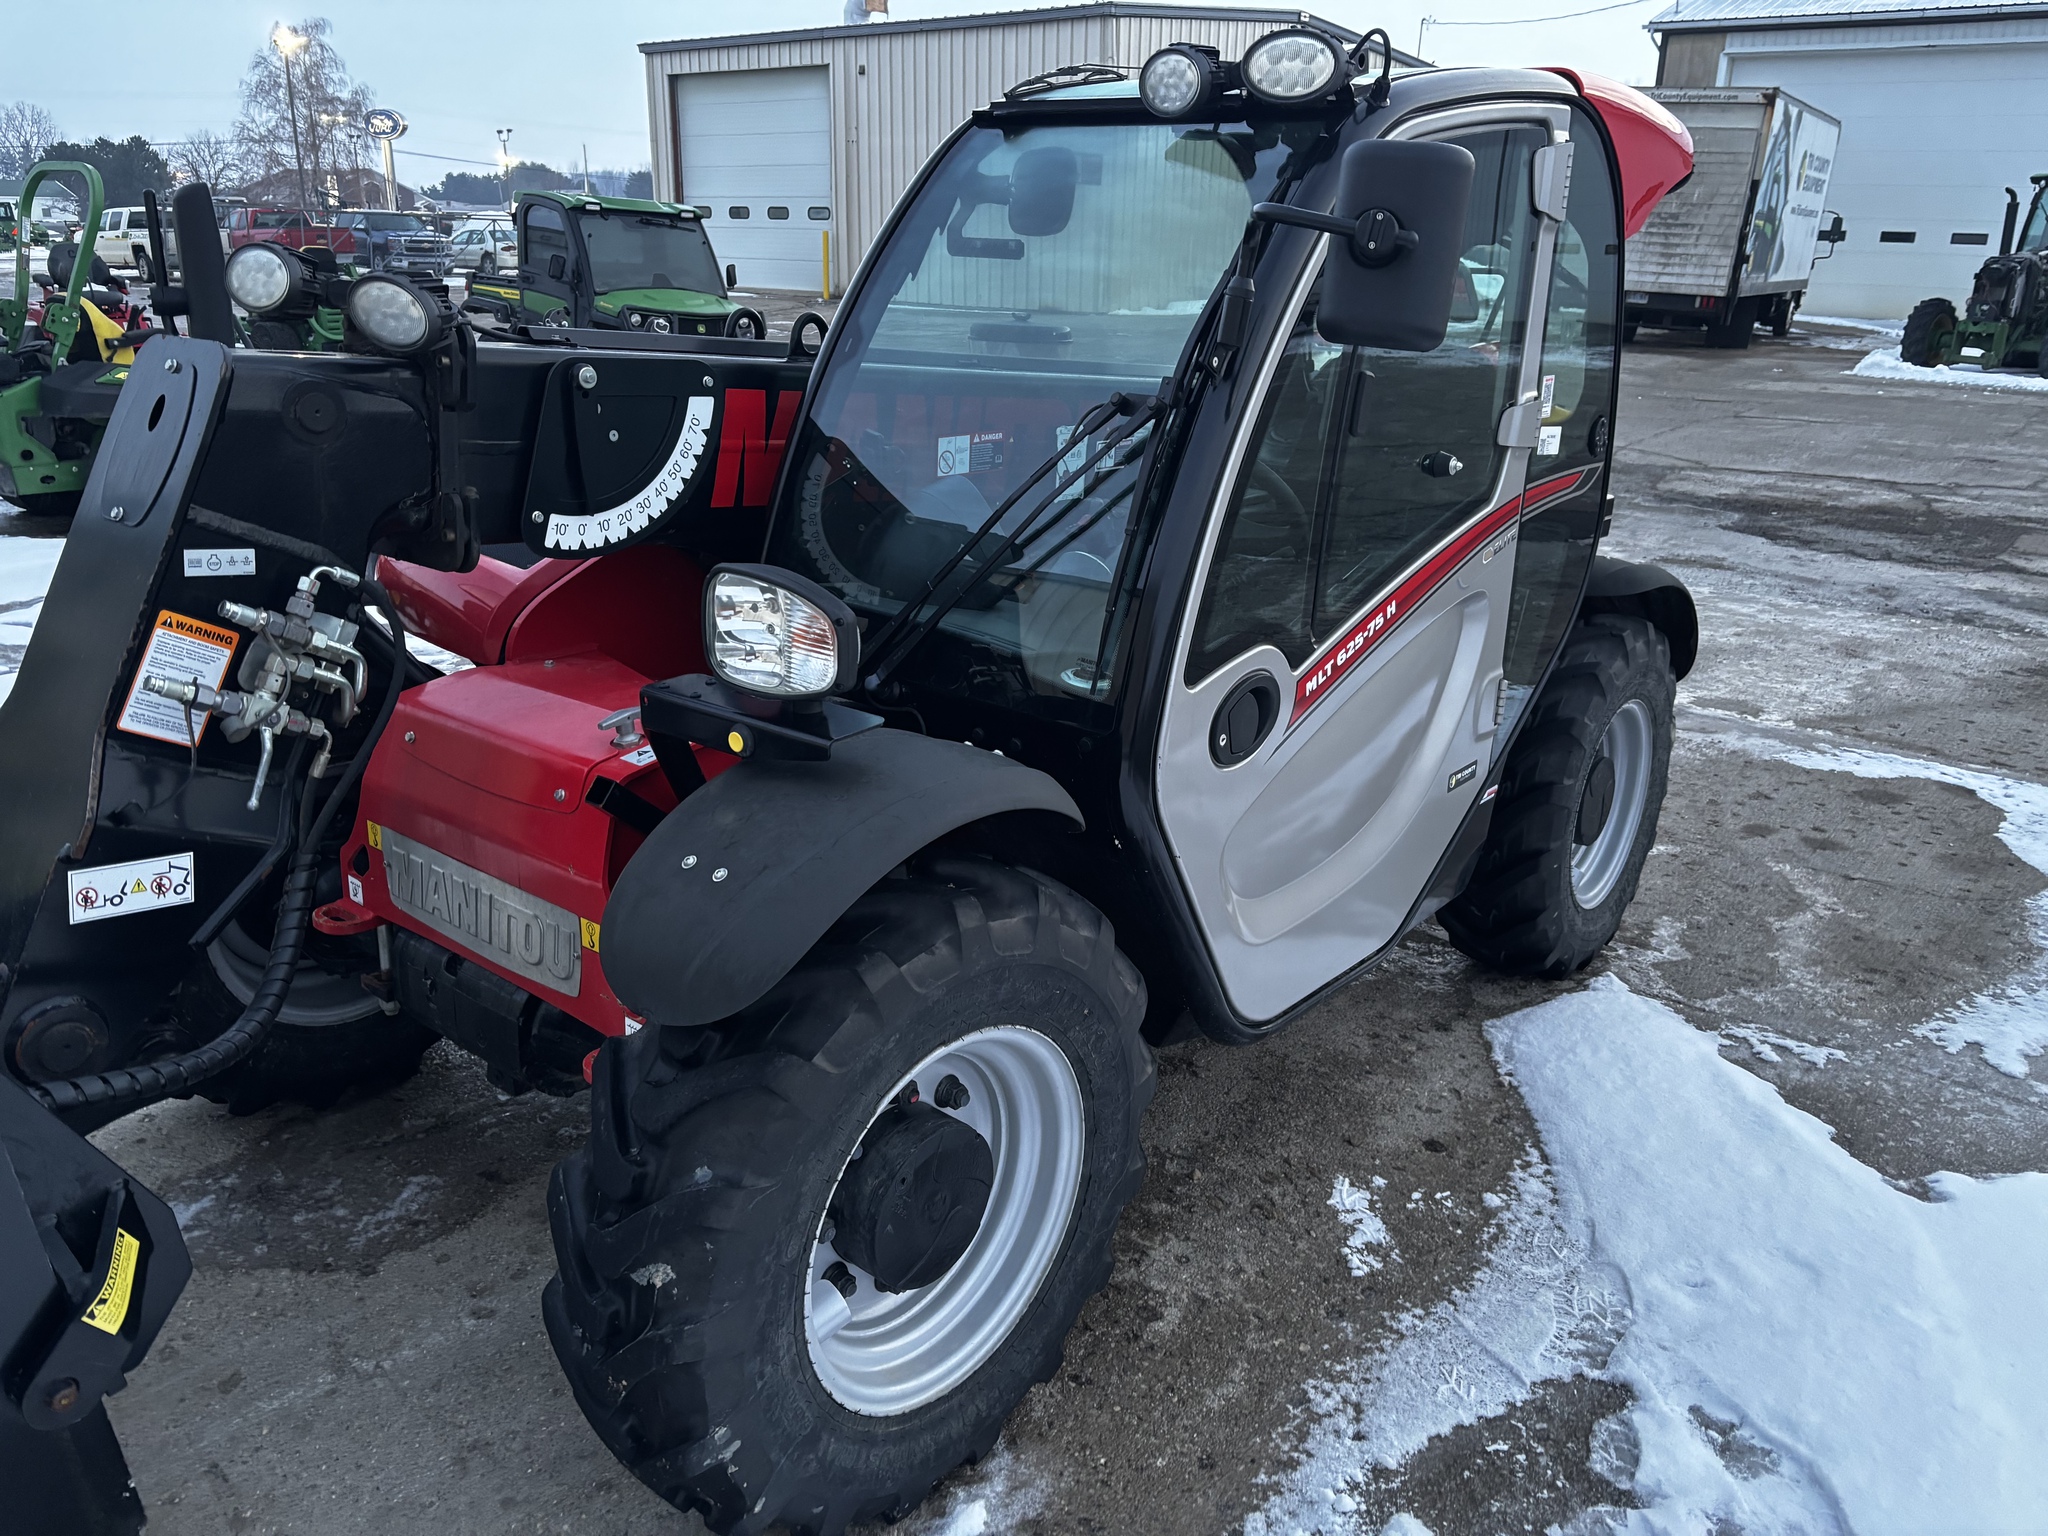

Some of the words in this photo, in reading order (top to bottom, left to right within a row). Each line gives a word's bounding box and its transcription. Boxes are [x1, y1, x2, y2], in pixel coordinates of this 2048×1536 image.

[981, 433, 1003, 441] DANGER
[176, 620, 234, 646] WARNING
[1306, 659, 1335, 697] MLT
[1336, 612, 1384, 666] 625-75
[1386, 600, 1396, 620] H
[391, 845, 576, 980] MANITOU
[101, 1236, 124, 1299] WARNING
